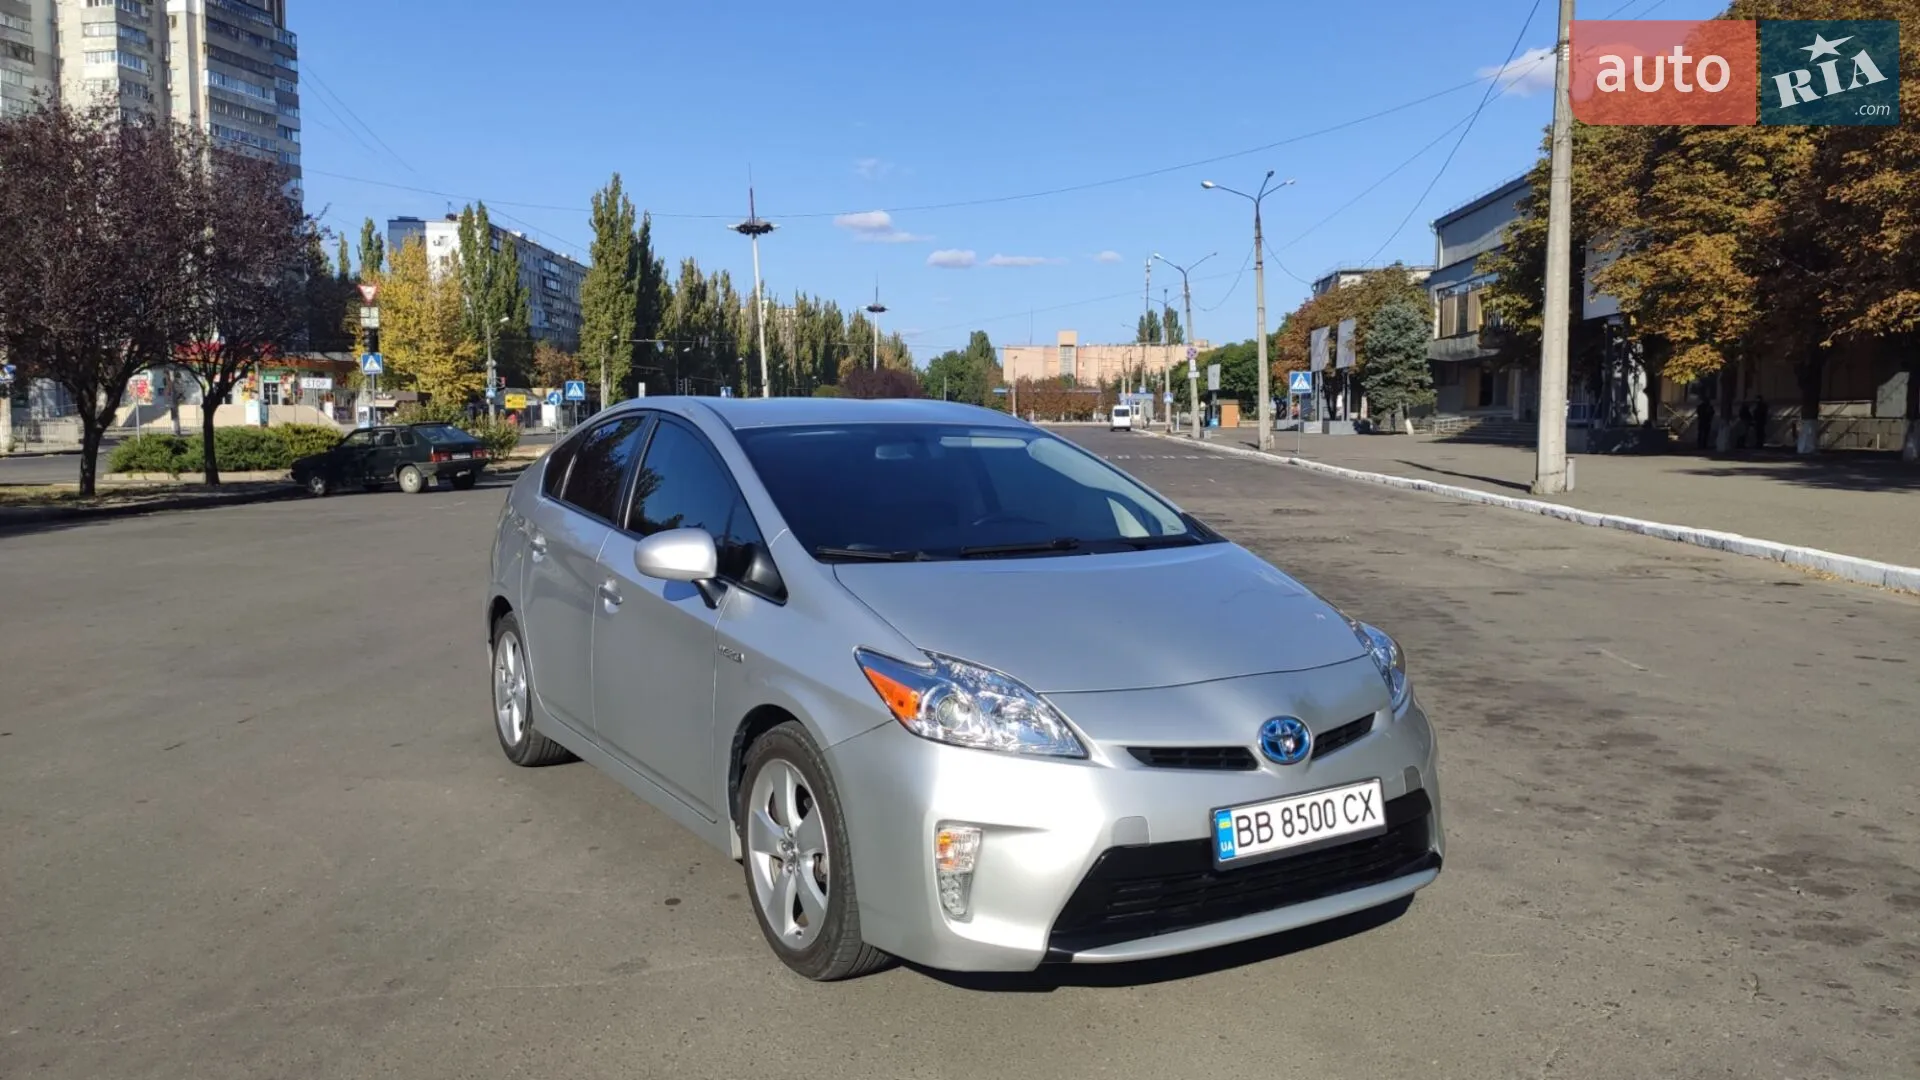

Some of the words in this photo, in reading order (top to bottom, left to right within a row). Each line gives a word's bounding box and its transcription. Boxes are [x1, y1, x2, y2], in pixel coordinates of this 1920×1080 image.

[1235, 811, 1274, 849] BB
[1281, 799, 1337, 838] 8500
[1343, 788, 1376, 825] CX
[1220, 842, 1234, 852] UA
